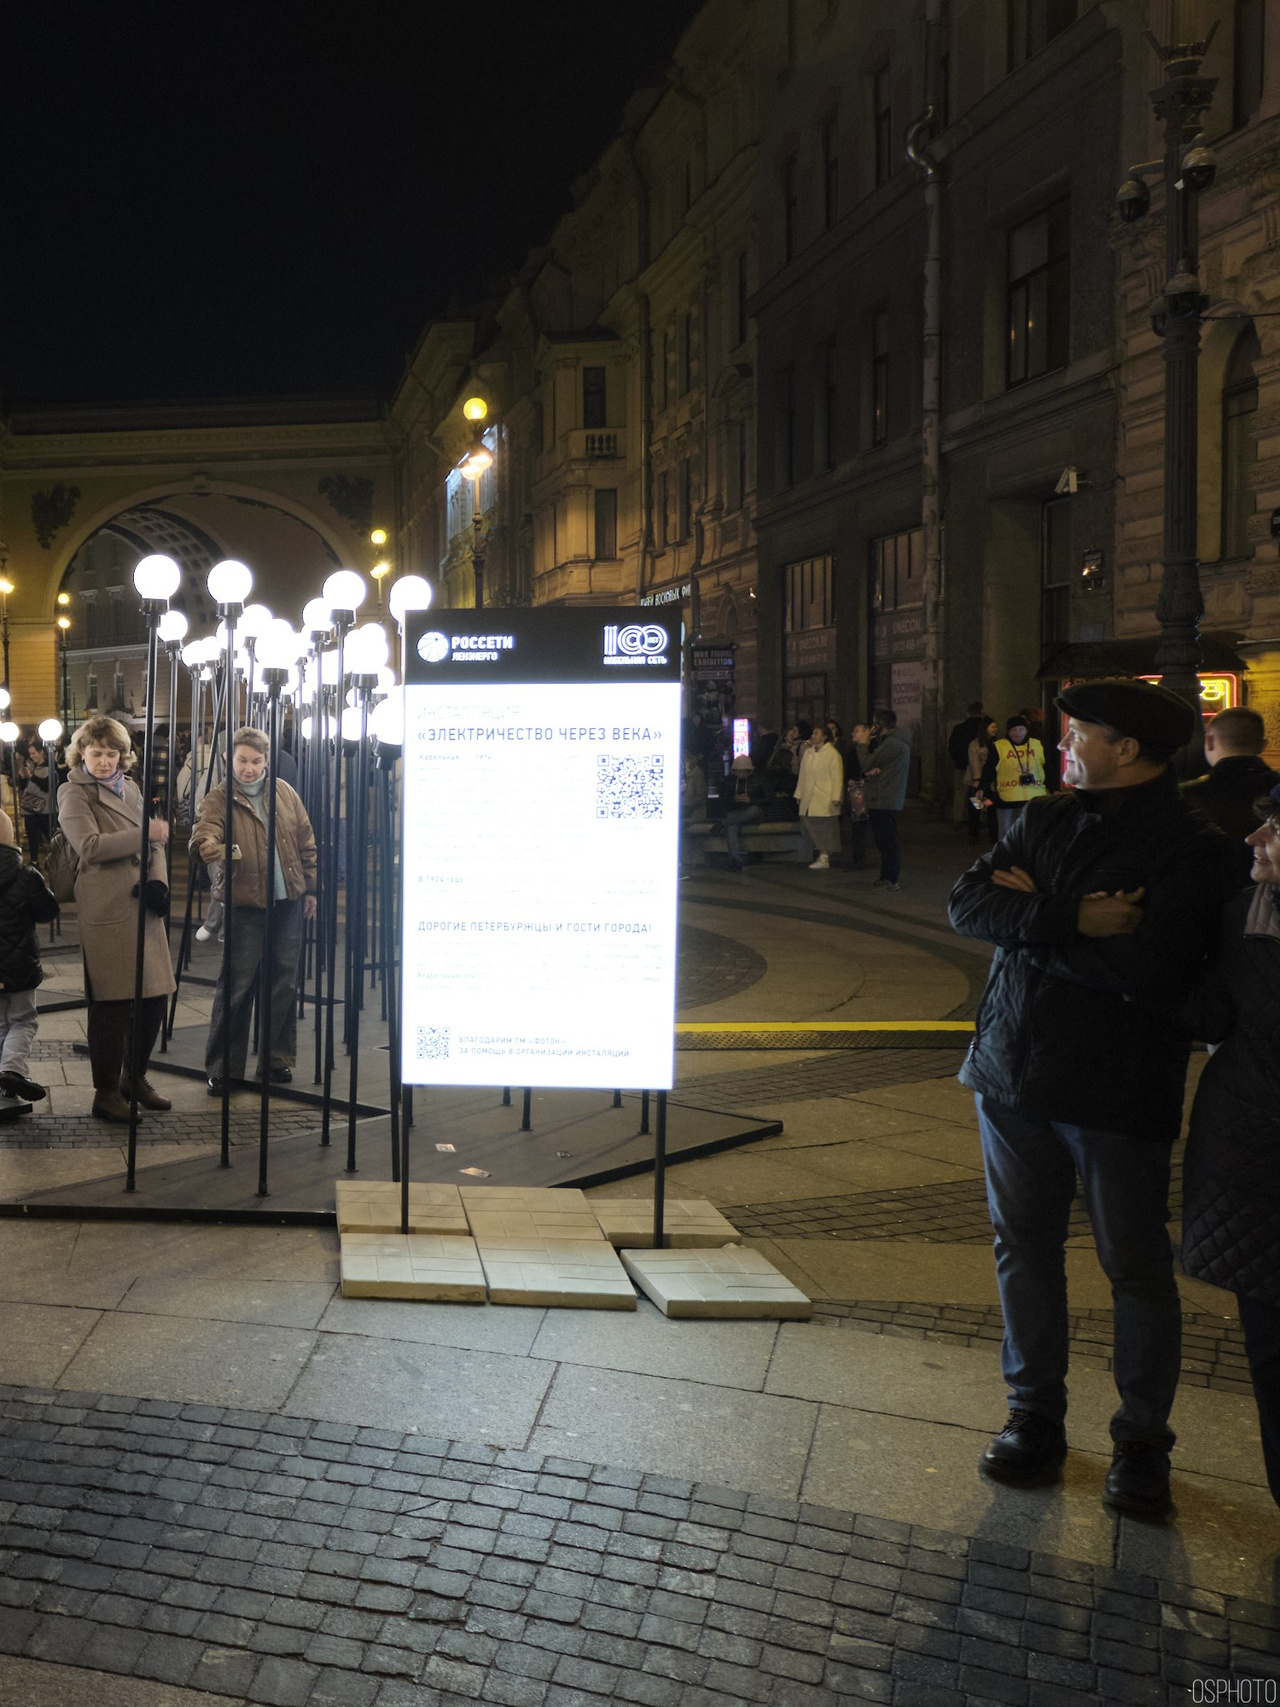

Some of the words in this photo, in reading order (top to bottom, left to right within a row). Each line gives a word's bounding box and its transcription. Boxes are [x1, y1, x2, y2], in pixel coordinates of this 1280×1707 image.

[451, 635, 514, 649] РОССЕТИ
[451, 651, 499, 661] ЛЕНЭНЕРГО
[647, 656, 668, 665] СЕТЬ
[417, 726, 554, 742] «ЭЛЕКТРИЧЕСТВО
[558, 726, 607, 741] ЧЕРЕЗ
[612, 726, 663, 741] ВЕКА»
[426, 875, 444, 883] 1924
[417, 921, 467, 933] ДОРОГИЕ
[470, 921, 552, 934] ПЕТЕРБУРЖЦЫ
[556, 922, 564, 932] И
[567, 922, 601, 933] ГОСТИ
[604, 922, 653, 935] ГОРОДА!
[459, 1036, 513, 1045] БЛАГОДАРИМ
[515, 1036, 527, 1045] ТМ
[459, 1046, 469, 1055] ЗА
[471, 1047, 506, 1056] ПОМОЩЬ
[508, 1047, 514, 1055] В
[516, 1047, 574, 1057] ОРГАНИЗАЦИИ
